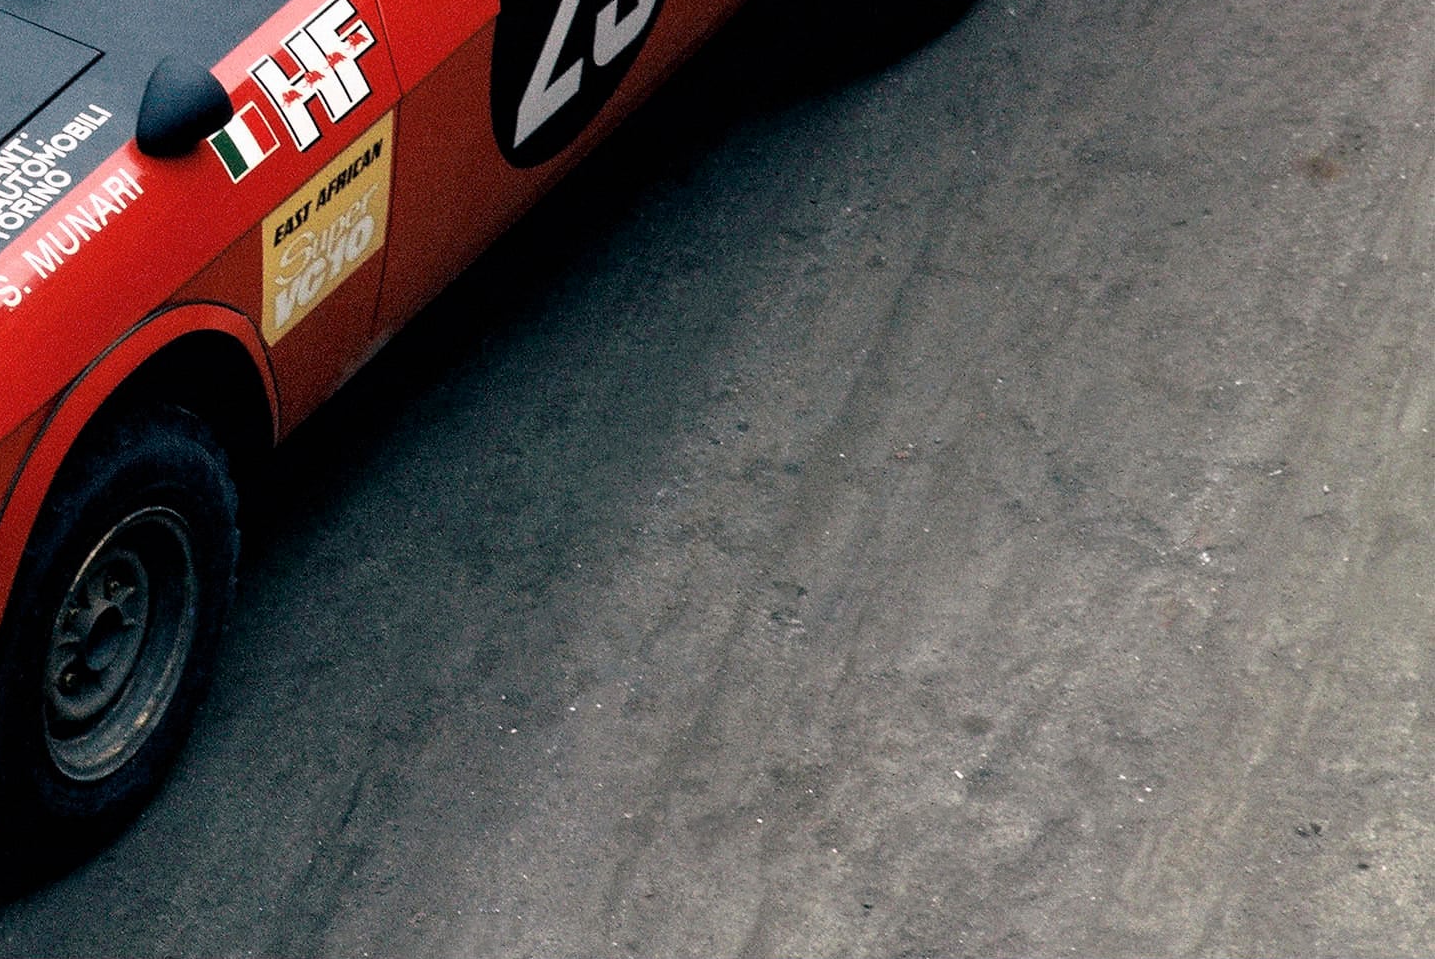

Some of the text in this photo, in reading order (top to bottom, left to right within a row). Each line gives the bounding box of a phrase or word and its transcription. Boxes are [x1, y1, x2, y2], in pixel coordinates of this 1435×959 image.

[21, 167, 144, 279] MUNARI
[273, 138, 383, 248] EAST AFRICAN
